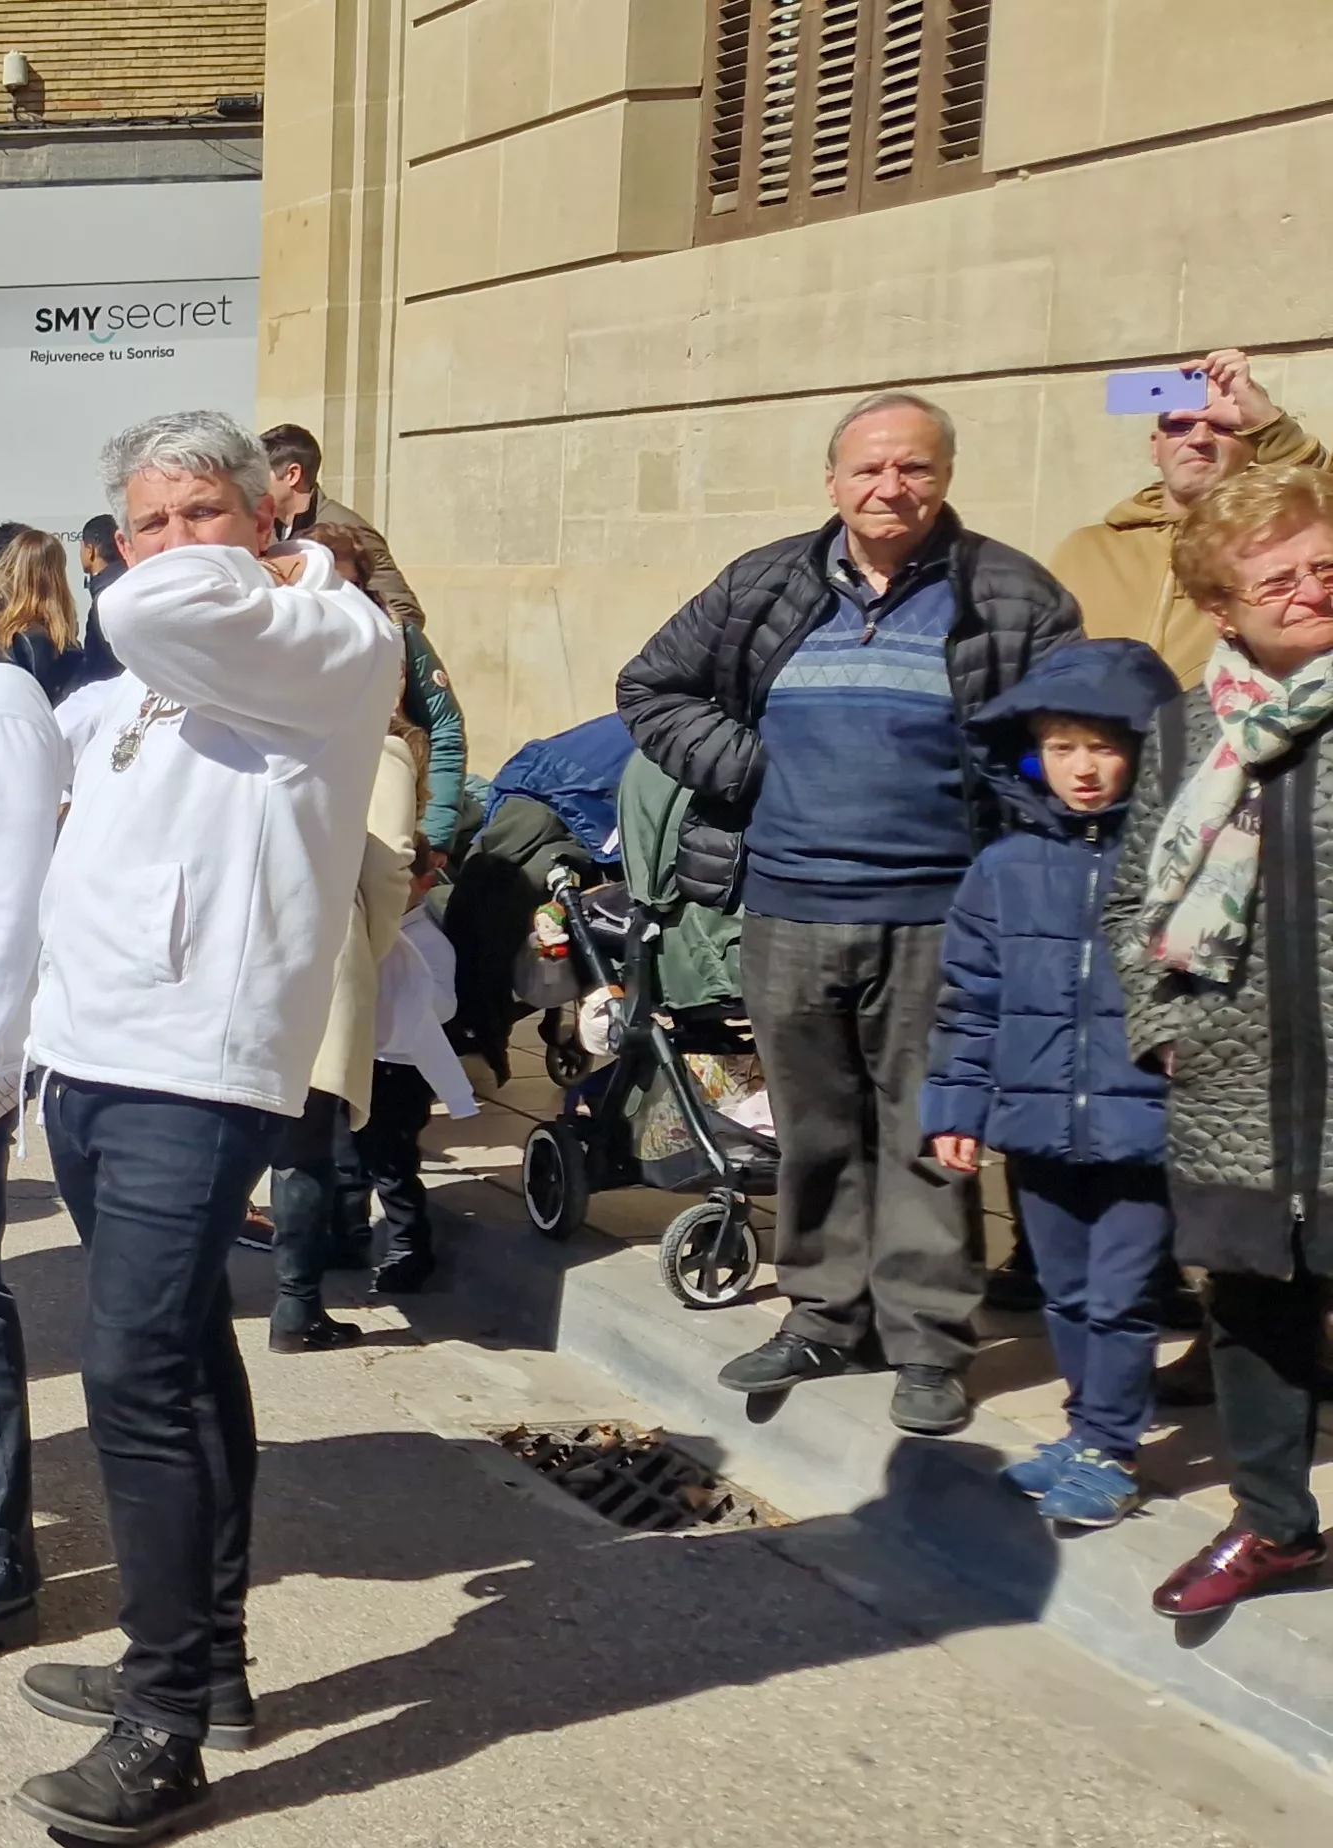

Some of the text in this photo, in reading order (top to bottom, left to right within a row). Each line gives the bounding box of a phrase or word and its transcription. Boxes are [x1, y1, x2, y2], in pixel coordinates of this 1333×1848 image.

[30, 345, 175, 366] Rejuvenece tu Sonrisa
